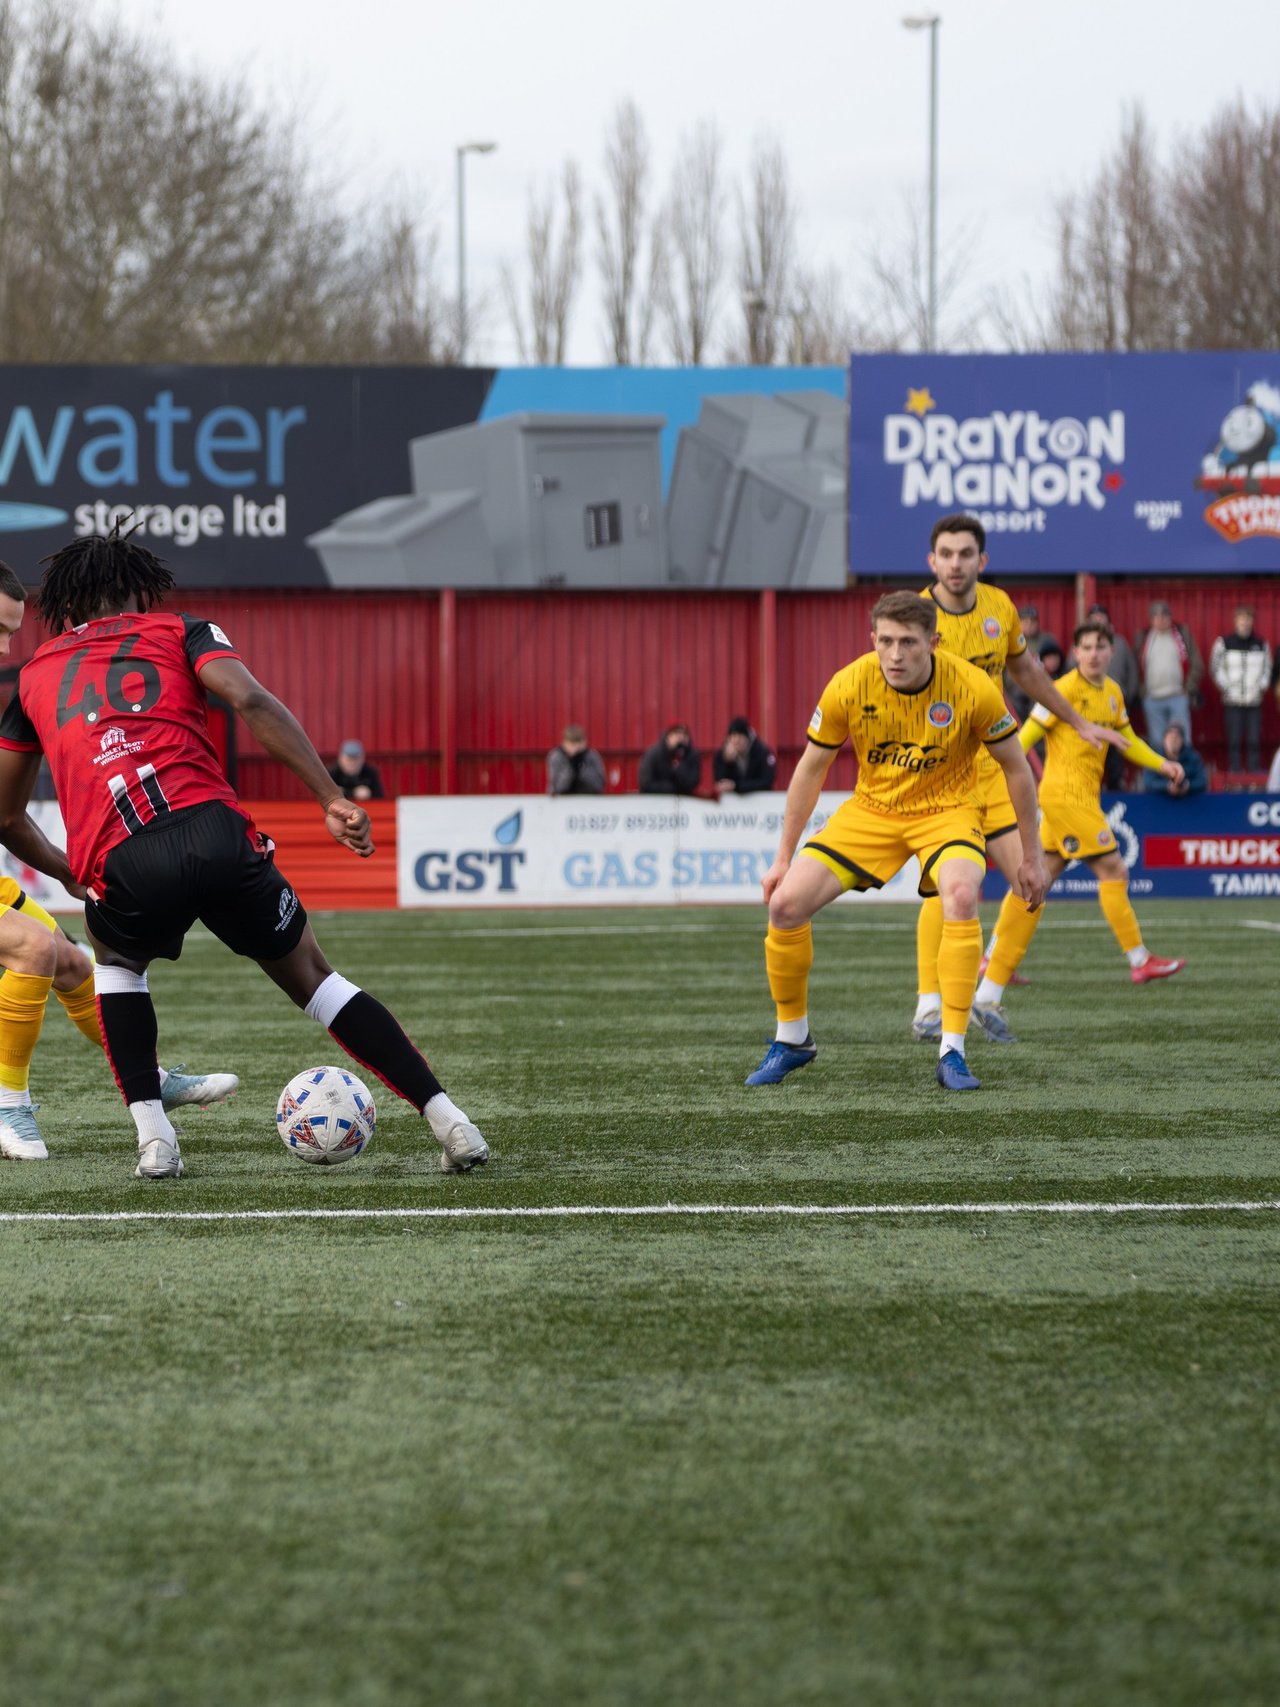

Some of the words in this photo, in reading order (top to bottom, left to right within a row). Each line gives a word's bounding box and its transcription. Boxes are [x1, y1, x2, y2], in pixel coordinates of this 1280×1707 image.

[74, 499, 225, 547] storage
[233, 493, 287, 537] ltd
[56, 633, 162, 731] 46
[93, 745, 122, 764] BRADLEY
[123, 741, 145, 749] SCOTT
[100, 750, 129, 766] WINDOWS
[129, 745, 141, 754] LTD
[567, 813, 619, 833] 01827
[414, 848, 526, 892] GST
[563, 851, 659, 888] GAS
